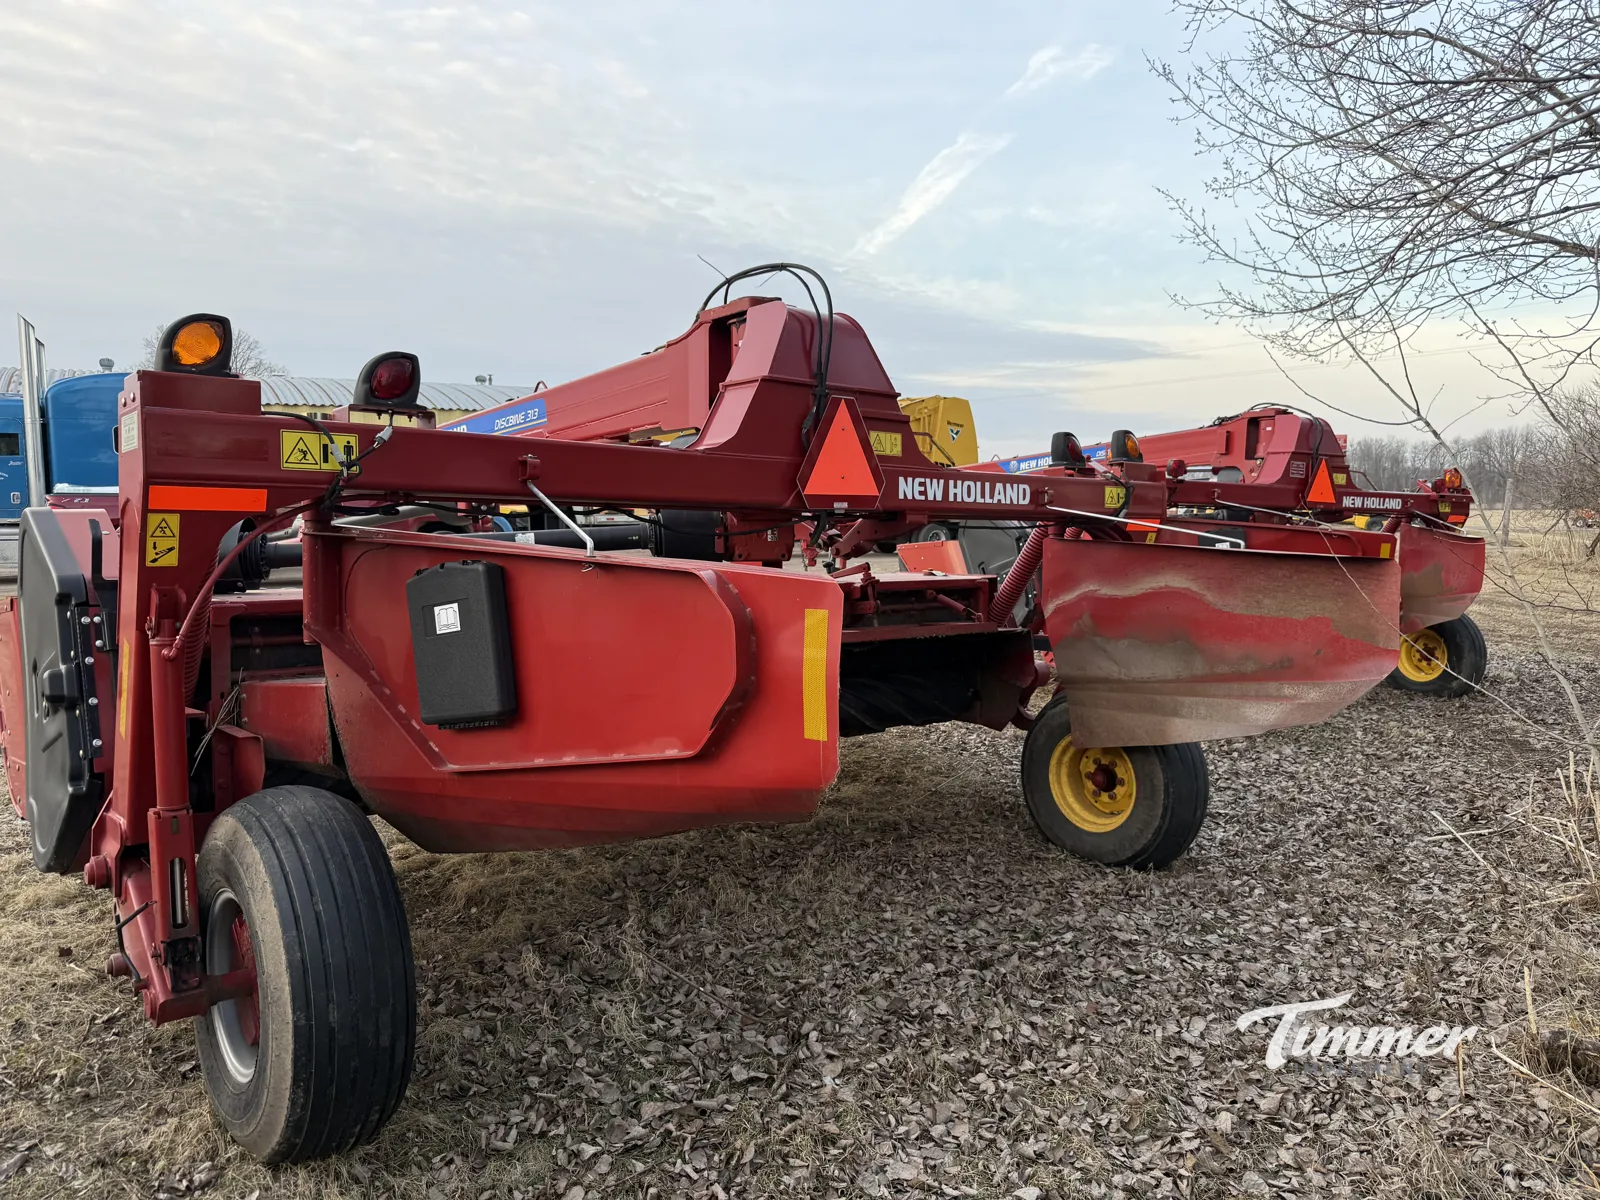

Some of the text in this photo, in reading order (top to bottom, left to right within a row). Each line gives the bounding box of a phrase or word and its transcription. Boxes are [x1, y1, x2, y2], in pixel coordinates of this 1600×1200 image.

[494, 408, 539, 430] DISCBINE 313
[1019, 459, 1037, 471] NEW
[898, 476, 1031, 505] NEW HOLLAND
[1342, 495, 1402, 510] NEW HOLLAND
